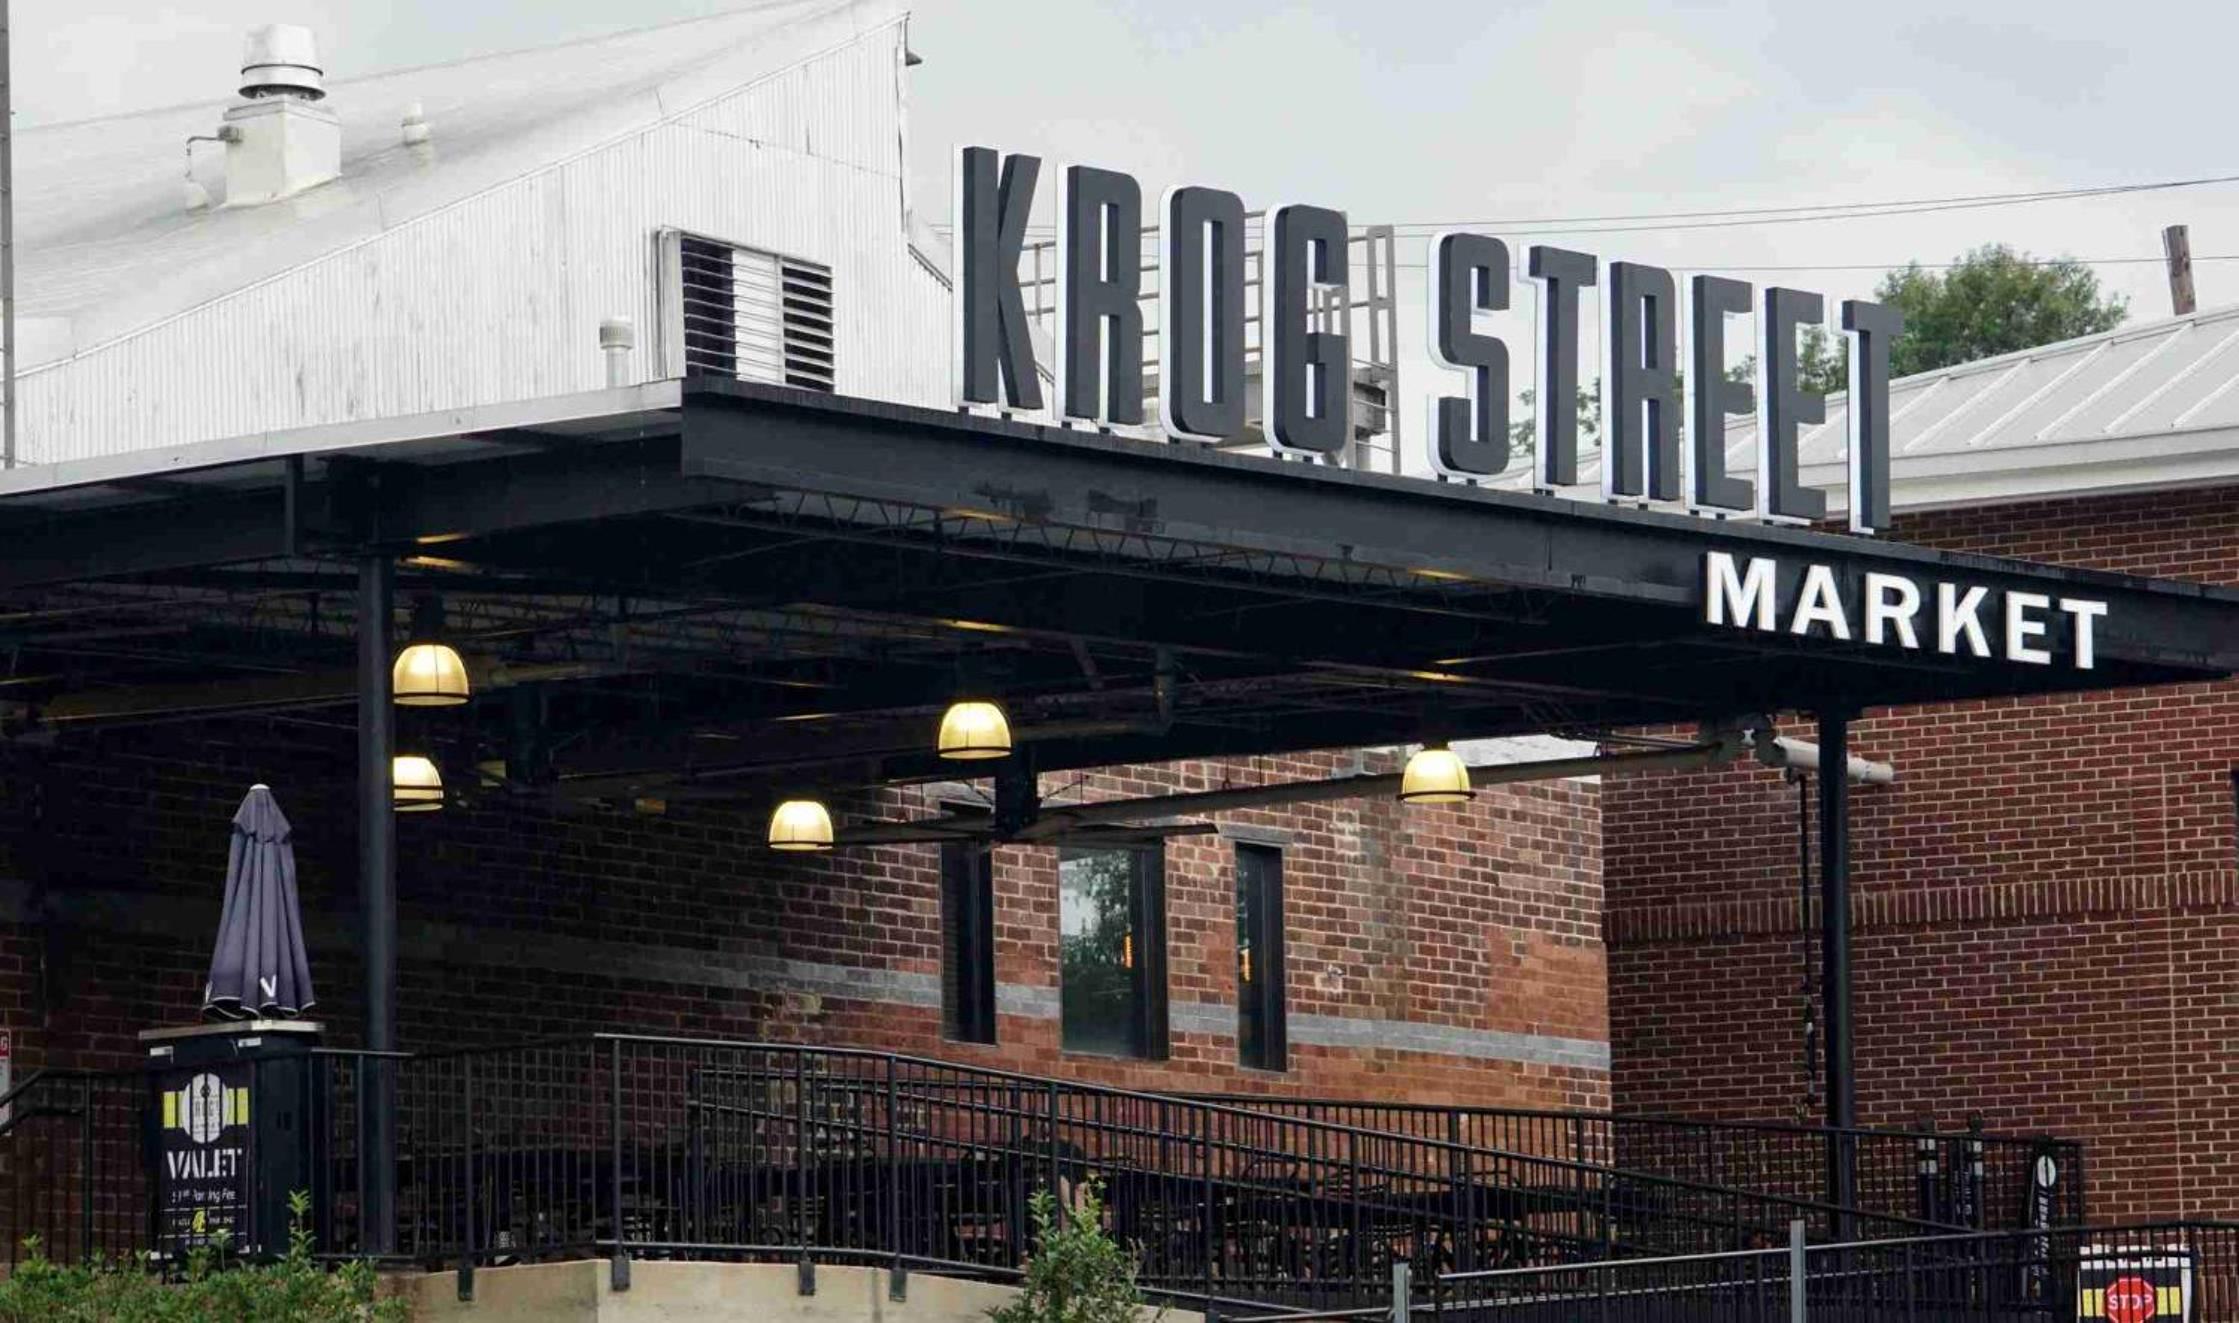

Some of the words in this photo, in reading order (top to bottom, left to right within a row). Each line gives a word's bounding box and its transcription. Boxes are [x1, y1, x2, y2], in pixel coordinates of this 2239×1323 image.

[953, 144, 1349, 459] KROG
[1428, 231, 1901, 535] STREET
[1707, 551, 2107, 669] MARKET
[260, 974, 277, 998] V
[167, 1148, 243, 1180] VALET
[2108, 1294, 2153, 1310] STOP
